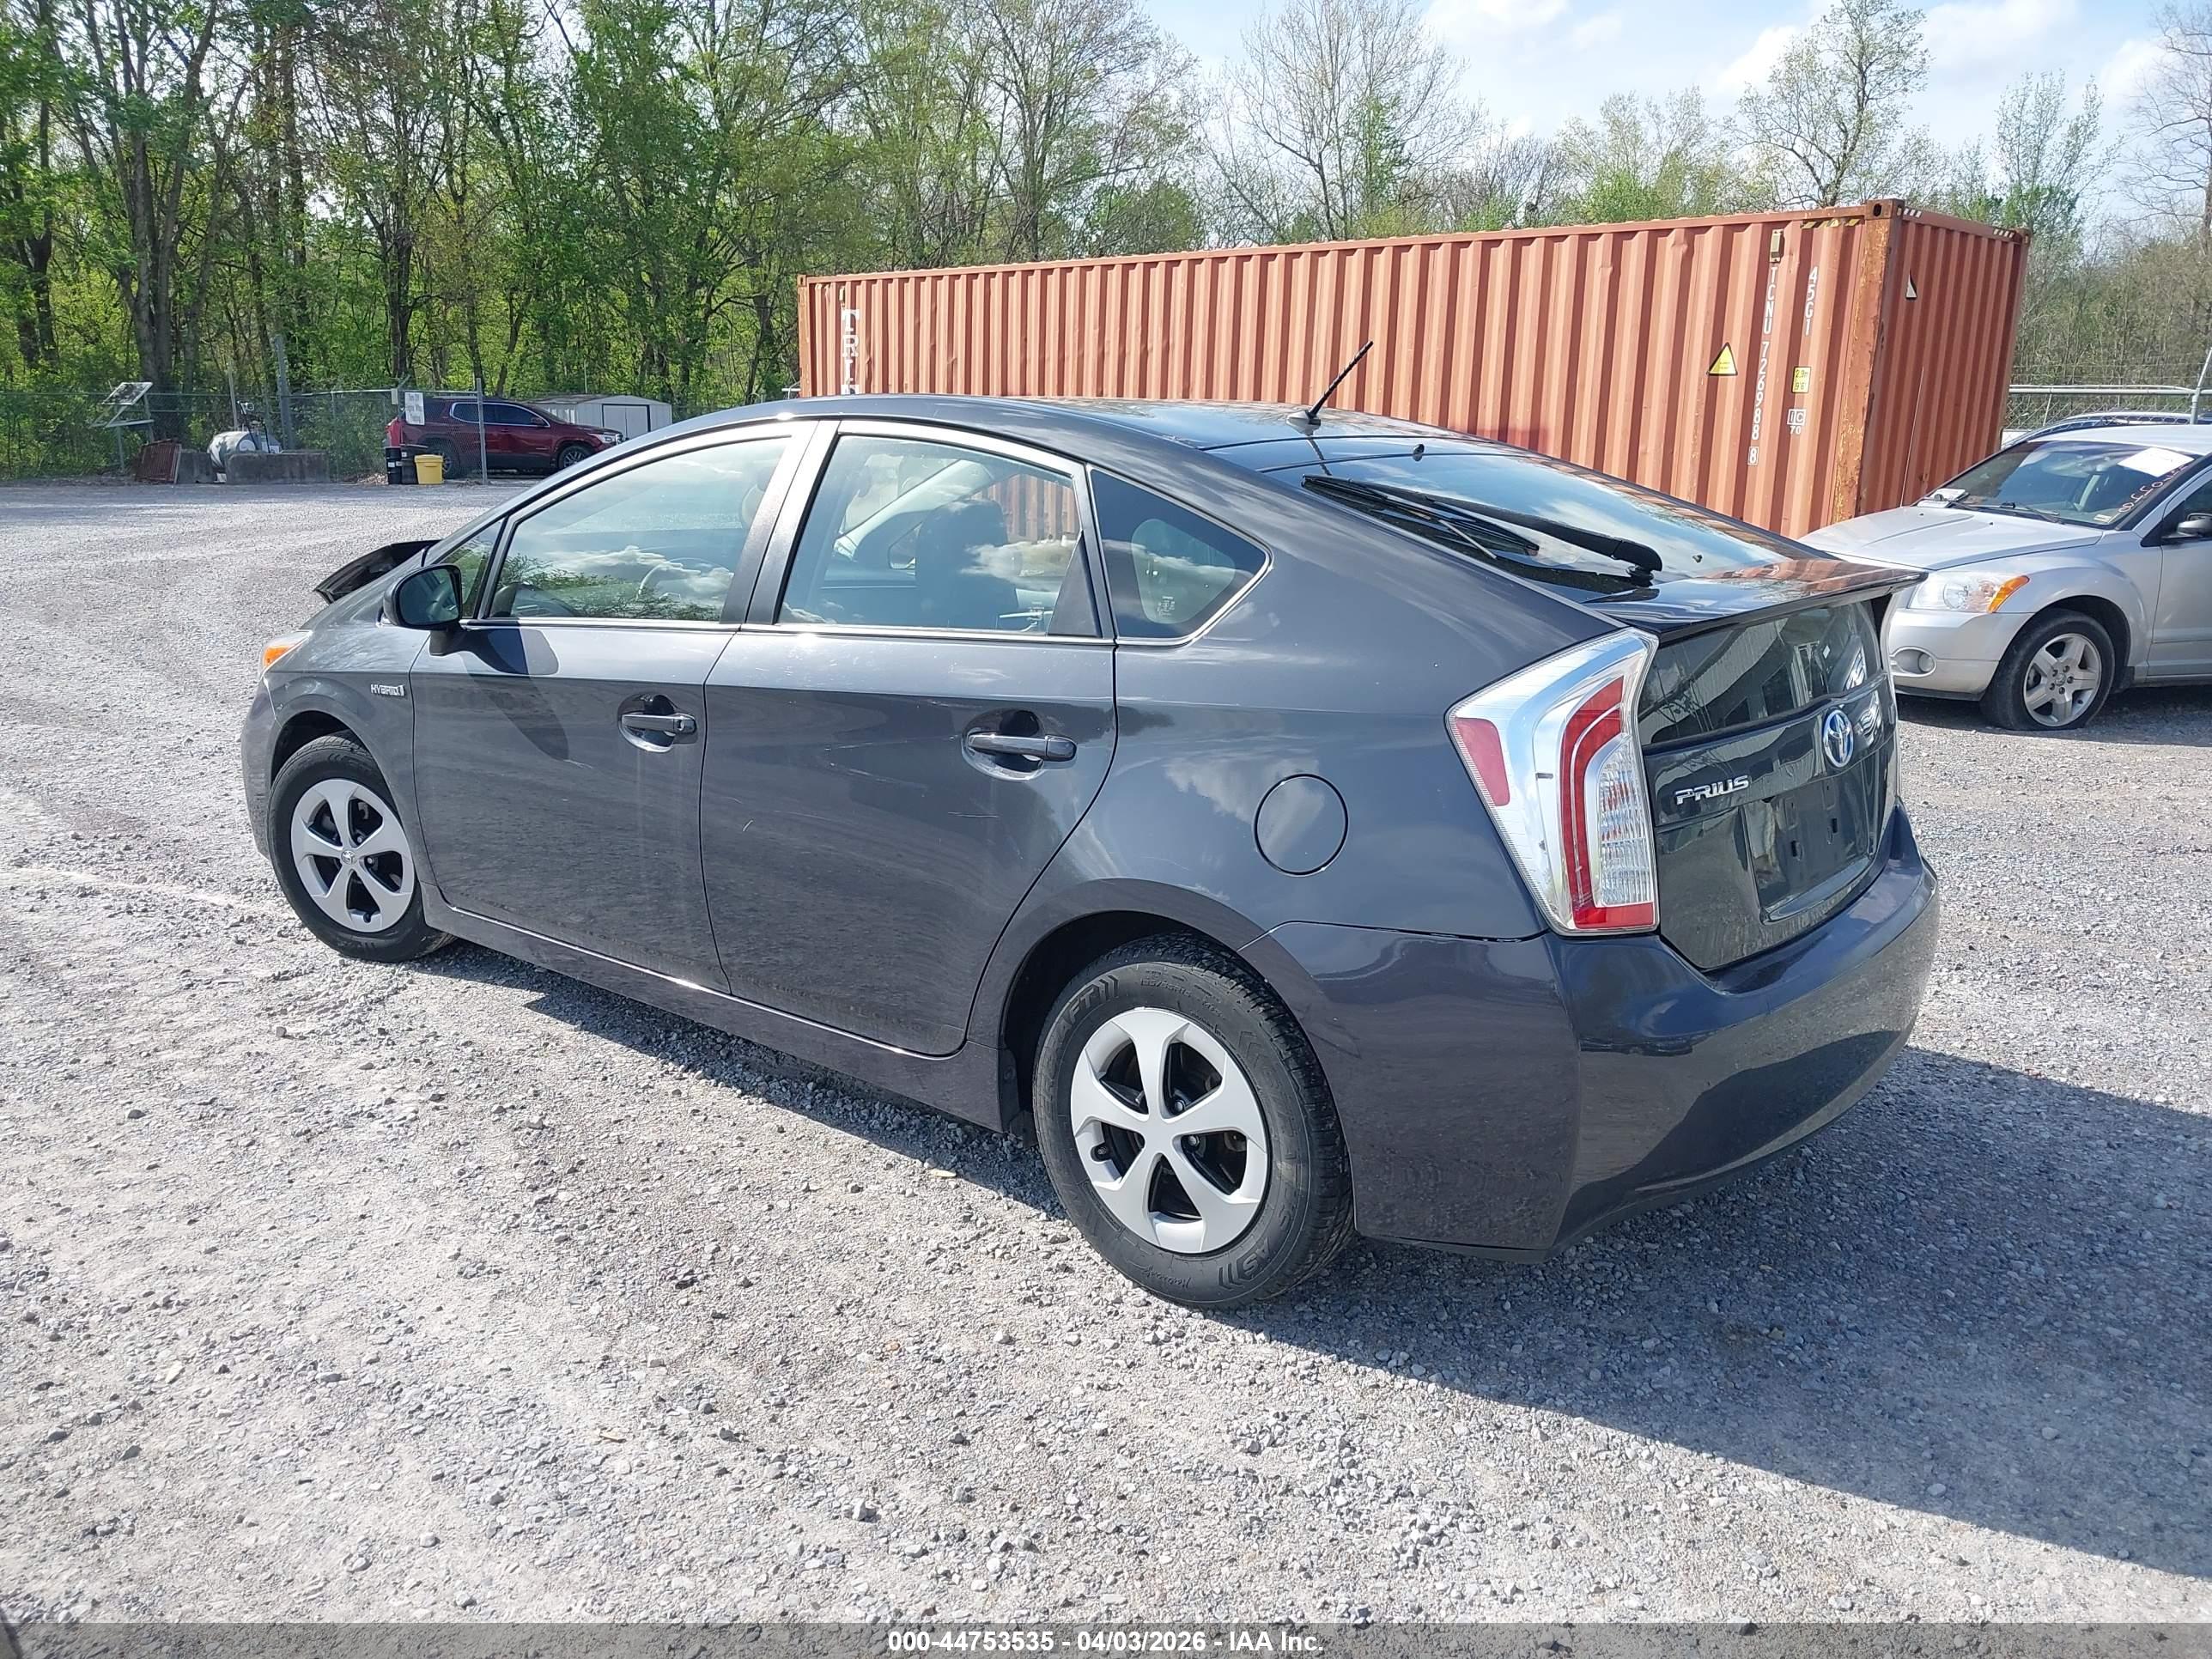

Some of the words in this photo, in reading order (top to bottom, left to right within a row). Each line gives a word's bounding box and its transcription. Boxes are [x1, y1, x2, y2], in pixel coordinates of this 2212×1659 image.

[1763, 266, 1778, 335] TCNU
[1805, 266, 1818, 336] 45G1
[1751, 341, 1770, 440] 726988
[1790, 425, 1802, 434] 70
[370, 684, 401, 696] HYBRID
[1674, 775, 1750, 805] PRIUS
